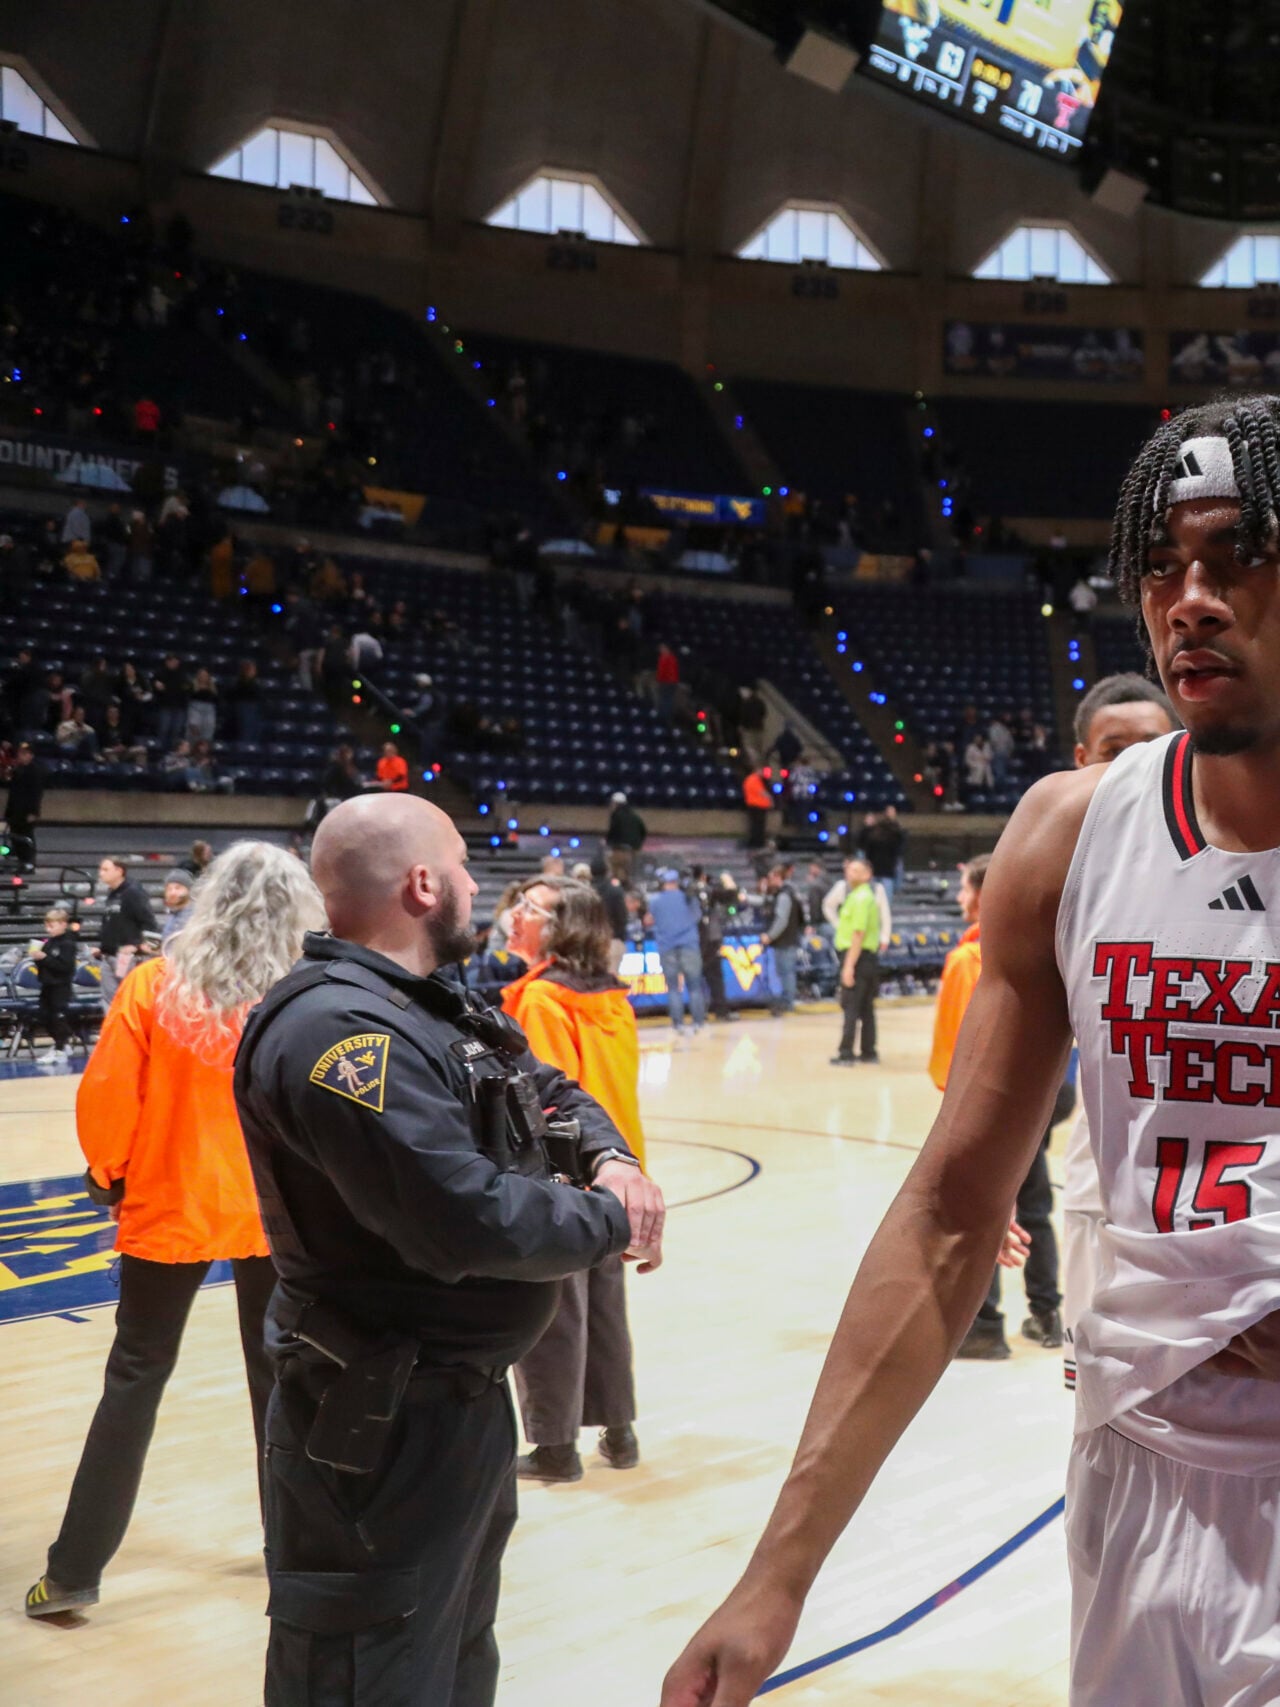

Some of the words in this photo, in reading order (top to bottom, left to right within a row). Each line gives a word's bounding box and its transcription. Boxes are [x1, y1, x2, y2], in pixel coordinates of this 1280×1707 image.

[277, 203, 333, 234] 233
[313, 1036, 385, 1080] UNIVERSITY
[353, 1077, 382, 1098] POLICE
[1151, 1137, 1266, 1233] 15
